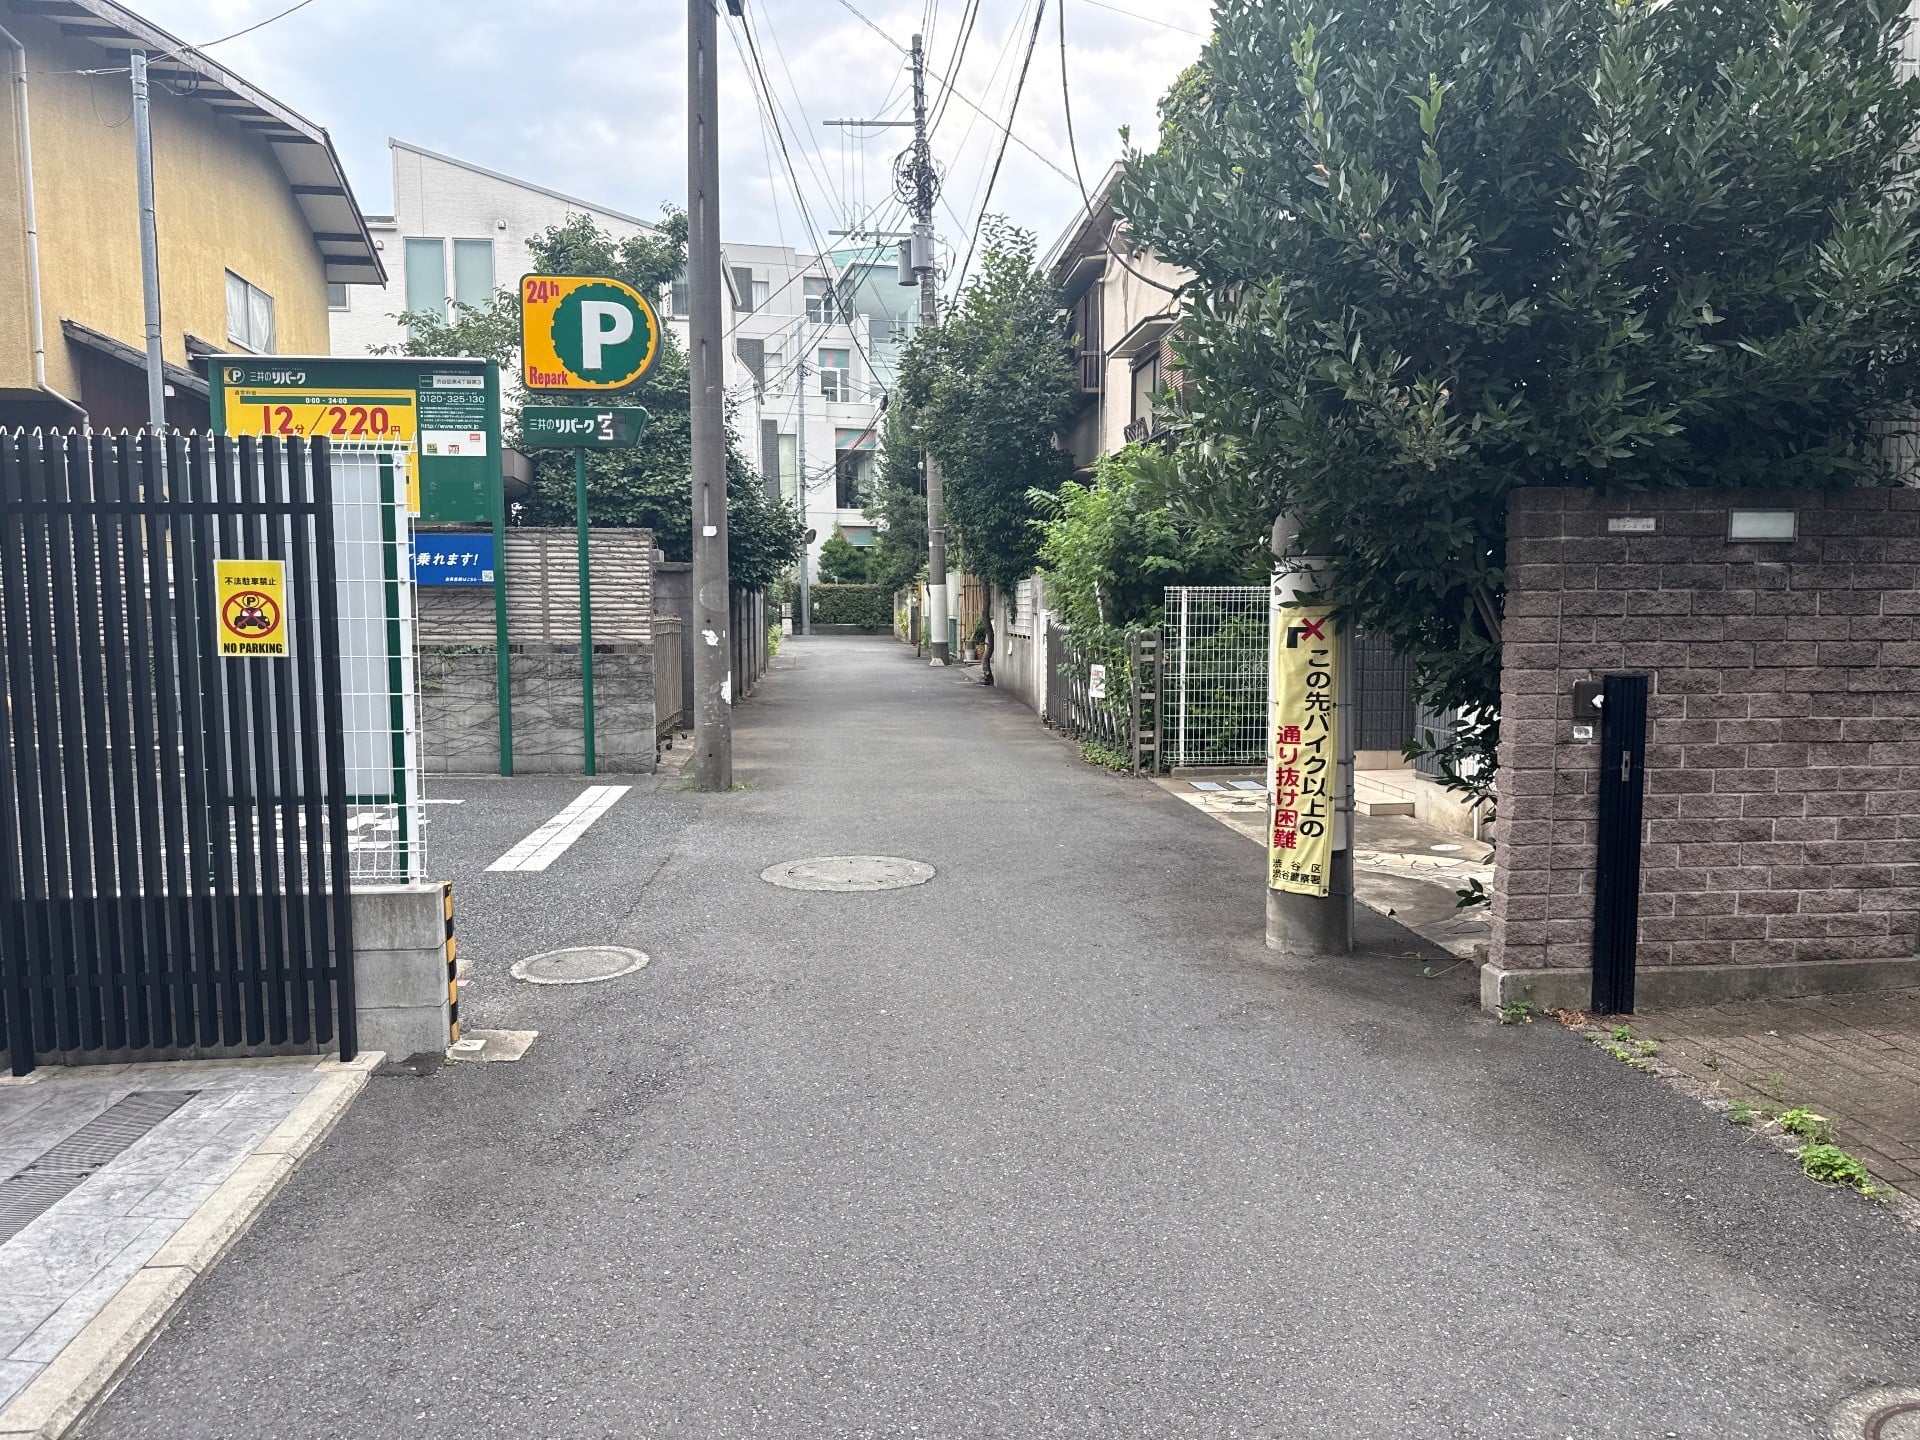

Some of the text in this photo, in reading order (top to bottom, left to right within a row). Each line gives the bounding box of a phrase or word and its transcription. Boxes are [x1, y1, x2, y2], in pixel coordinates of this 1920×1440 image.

[526, 280, 559, 303] 24h
[580, 300, 634, 370] P
[249, 371, 306, 385] 三井のリパーク
[529, 366, 568, 387] Repark
[420, 395, 485, 403] 0120-325-130
[529, 418, 595, 434] 三井のリパーク
[224, 577, 276, 586] 不法駐車禁止
[223, 642, 283, 654] NO PARKING
[1299, 649, 1332, 838] この先バイク以上の
[1273, 725, 1302, 850] 通り抜け困難
[1272, 869, 1321, 884] 渋谷警察署
